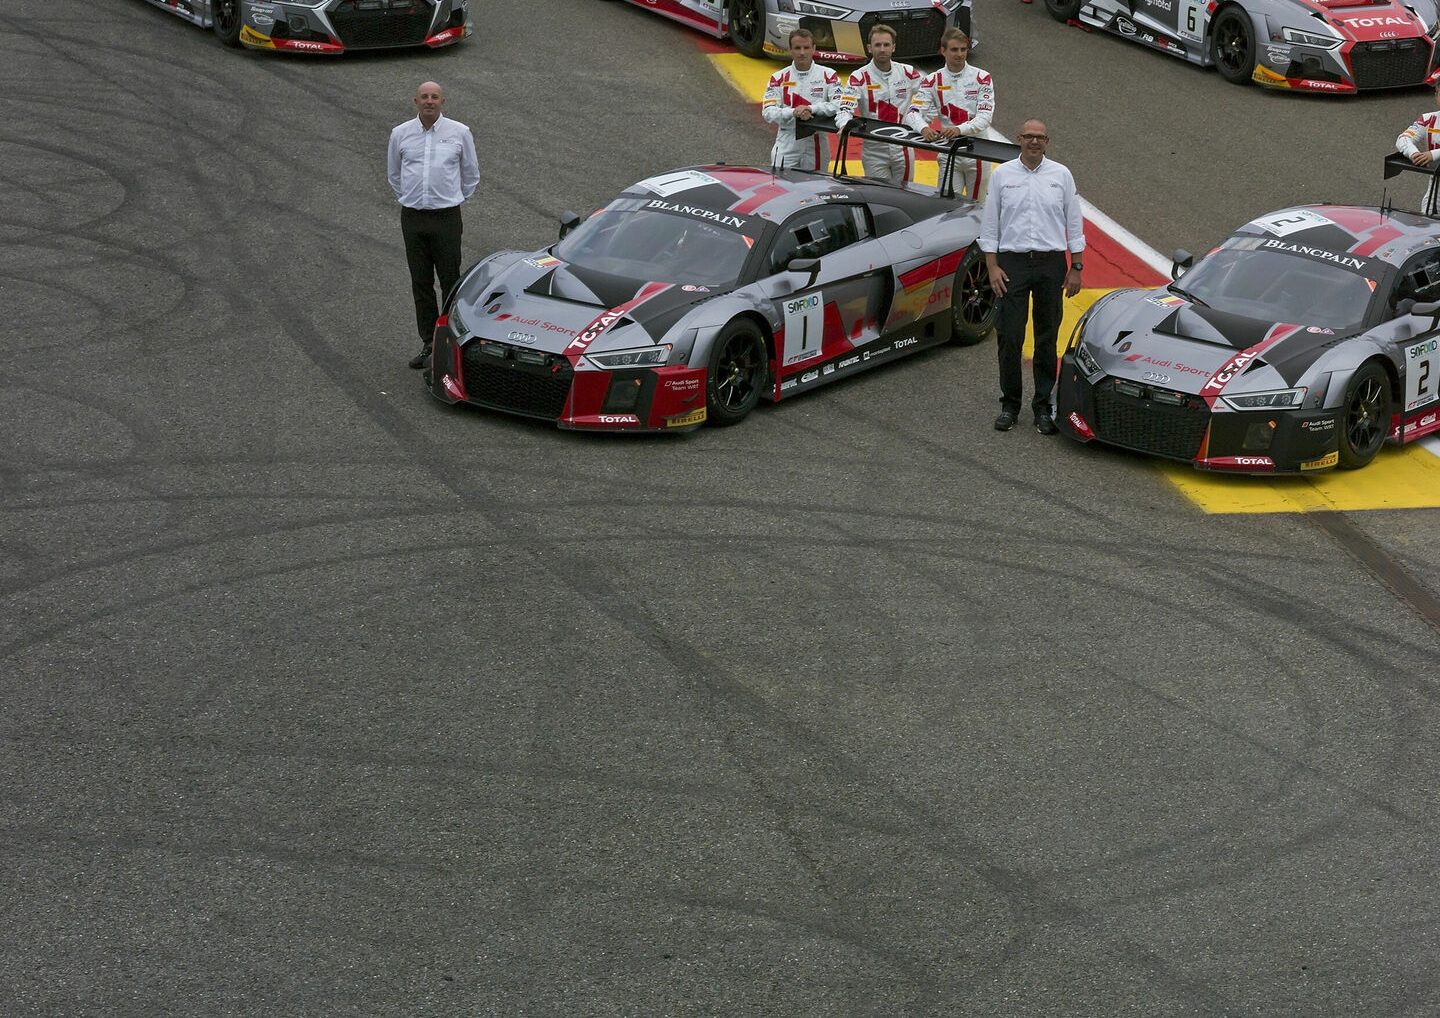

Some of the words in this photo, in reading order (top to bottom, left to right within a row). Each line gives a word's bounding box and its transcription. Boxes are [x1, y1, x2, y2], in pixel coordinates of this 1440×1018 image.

[1188, 6, 1197, 32] 6
[1344, 17, 1412, 28] TOTAL
[436, 32, 452, 41] TOTAL
[293, 41, 324, 50] TOTAL
[818, 52, 849, 61] TOTAL
[1308, 81, 1338, 90] TOTAL
[648, 200, 747, 229] BLANCPAIN
[1264, 239, 1366, 270] BLANCPAIN
[510, 315, 539, 327] Audi
[541, 321, 577, 337] Sport
[568, 309, 626, 351] TOTAL
[801, 316, 808, 349] 1
[893, 336, 918, 349] TOTAL
[1142, 357, 1173, 370] Audi
[1174, 361, 1211, 377] Sport
[1204, 350, 1257, 391] TOTAL
[441, 373, 453, 389] TOTAL
[1417, 360, 1430, 396] 2
[598, 415, 636, 423] TOTAL
[672, 412, 705, 425] PIRELLI
[1069, 412, 1083, 428] TOTAL
[1235, 456, 1272, 465] TOTAL
[1304, 454, 1336, 468] PIRELLI
